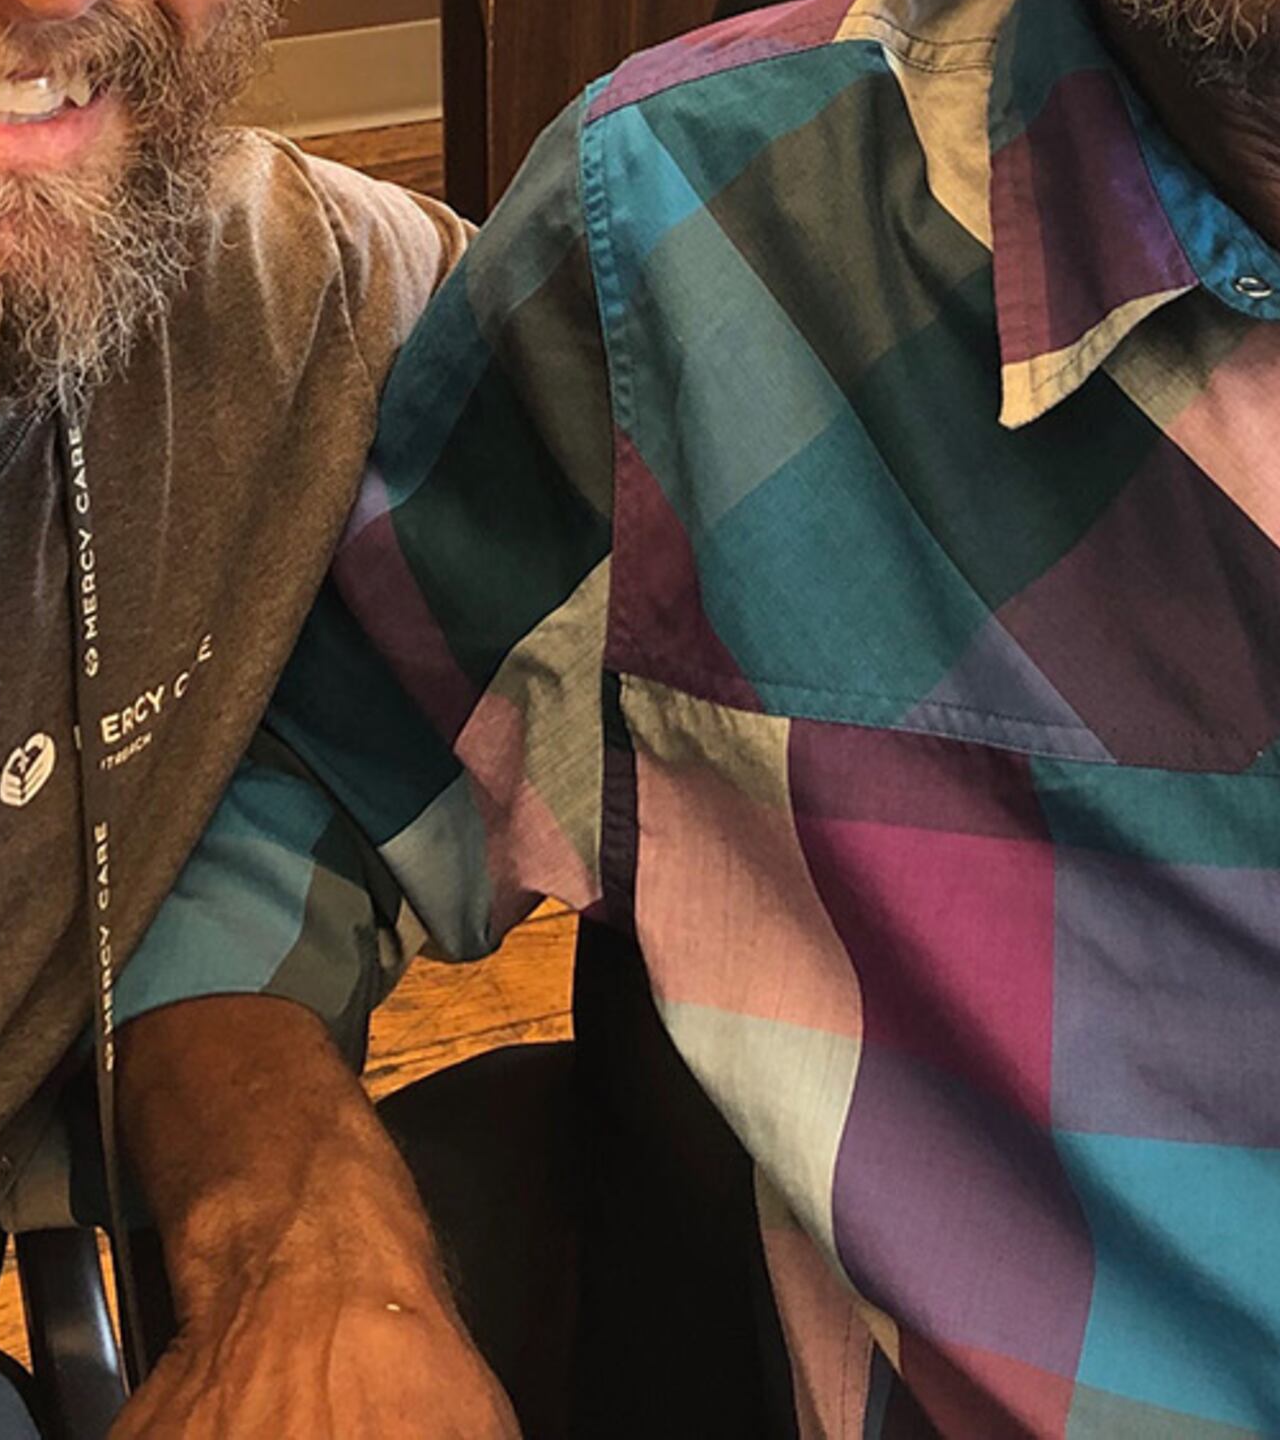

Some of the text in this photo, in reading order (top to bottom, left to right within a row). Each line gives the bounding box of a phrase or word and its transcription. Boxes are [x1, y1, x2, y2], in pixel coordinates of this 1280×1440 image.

[69, 426, 99, 640] MERCY CARE
[74, 633, 213, 750] ERCY CE
[94, 822, 110, 910] CARE
